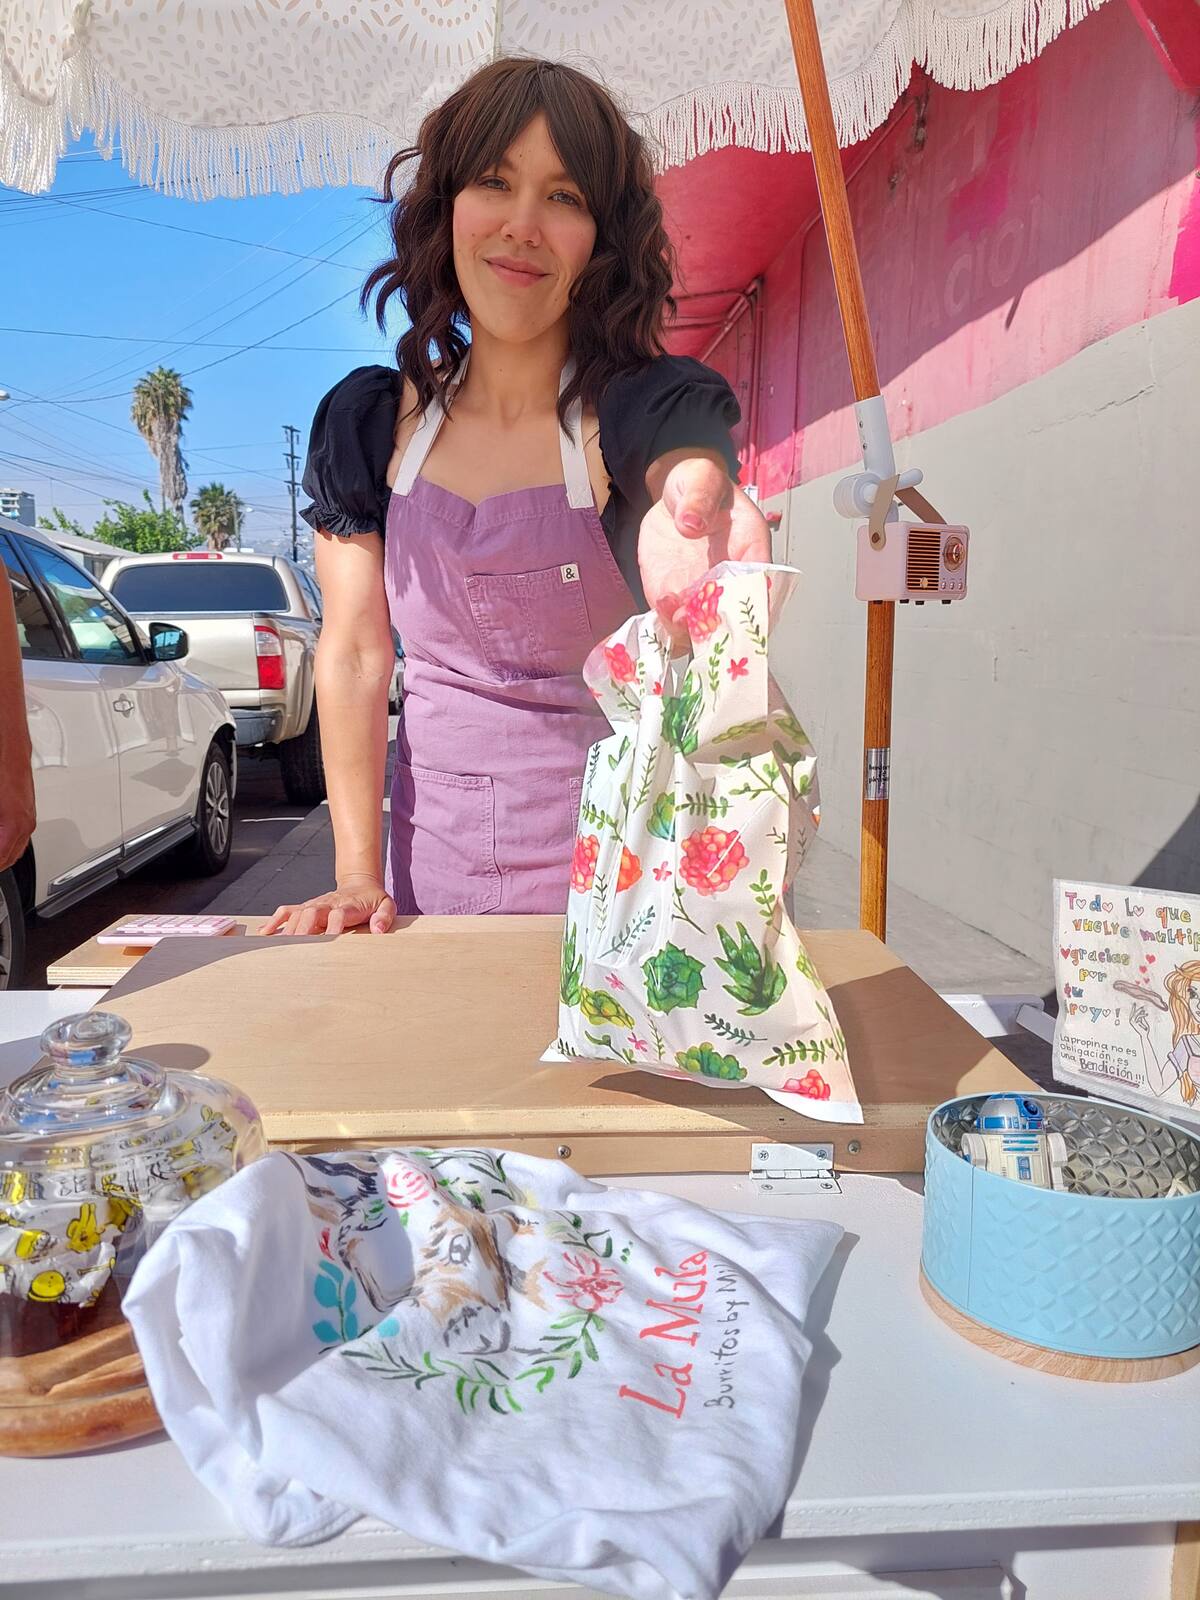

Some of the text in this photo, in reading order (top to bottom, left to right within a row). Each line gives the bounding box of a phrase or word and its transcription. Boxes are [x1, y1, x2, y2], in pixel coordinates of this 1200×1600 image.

[1065, 891, 1113, 913] Todo
[1156, 906, 1191, 929] que
[1070, 948, 1129, 966] gracias
[1079, 968, 1107, 982] por
[1061, 1052, 1076, 1062] una
[1071, 1037, 1108, 1050] propina
[1126, 1048, 1137, 1057] es
[1118, 1057, 1128, 1067] es
[717, 1300, 750, 1322] by
[619, 1249, 708, 1418] La Mula
[704, 1328, 740, 1408] Burritos
